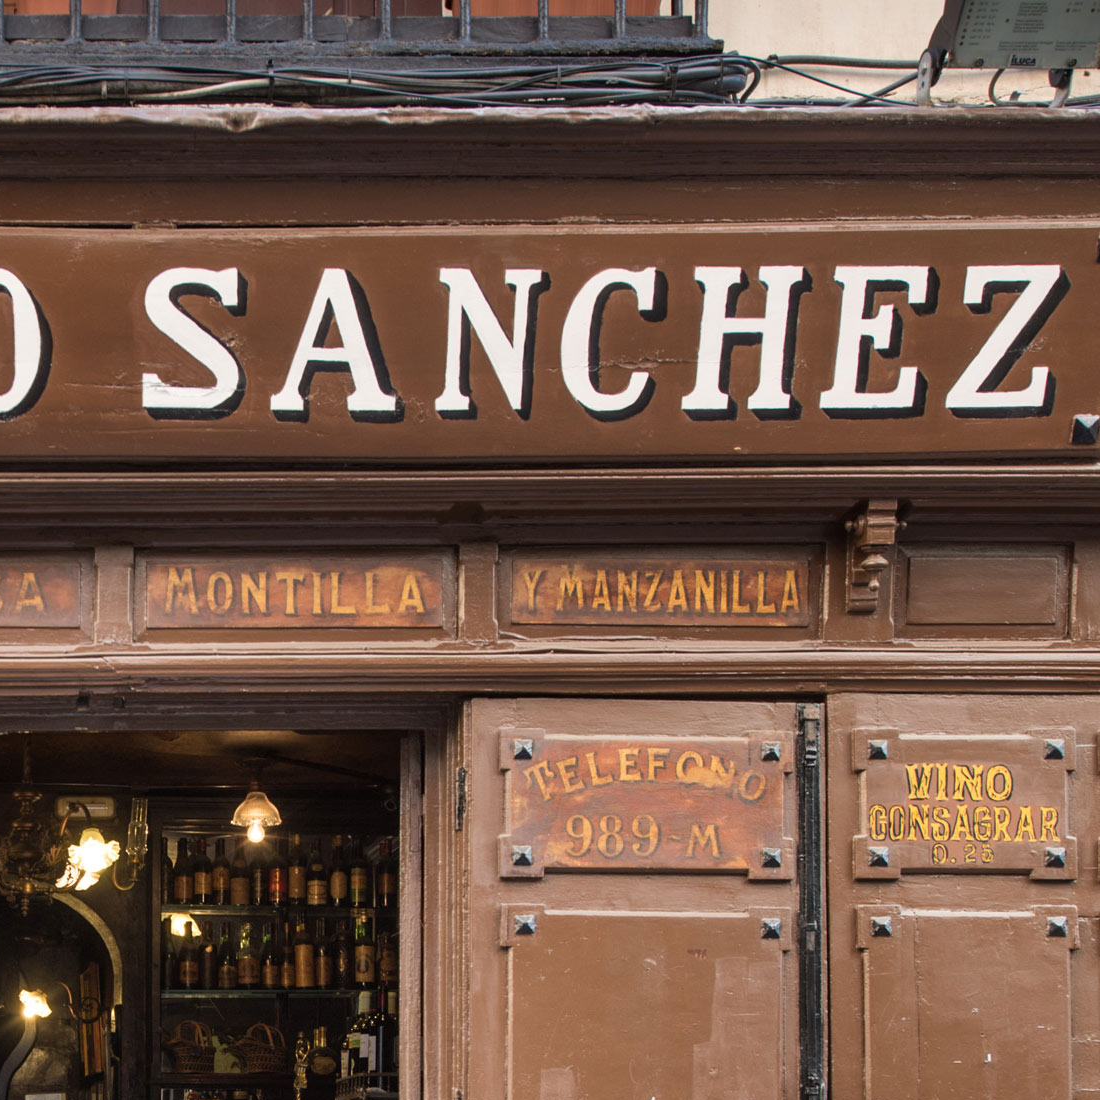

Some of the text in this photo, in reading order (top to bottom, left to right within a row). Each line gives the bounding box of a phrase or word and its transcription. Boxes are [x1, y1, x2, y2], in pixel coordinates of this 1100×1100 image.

[142, 265, 1068, 420] SANCHEZ
[165, 567, 426, 616] MONTILLA
[523, 564, 800, 615] Y MANZANILLA
[523, 747, 768, 802] TELEFONO
[905, 762, 1014, 801] VINO
